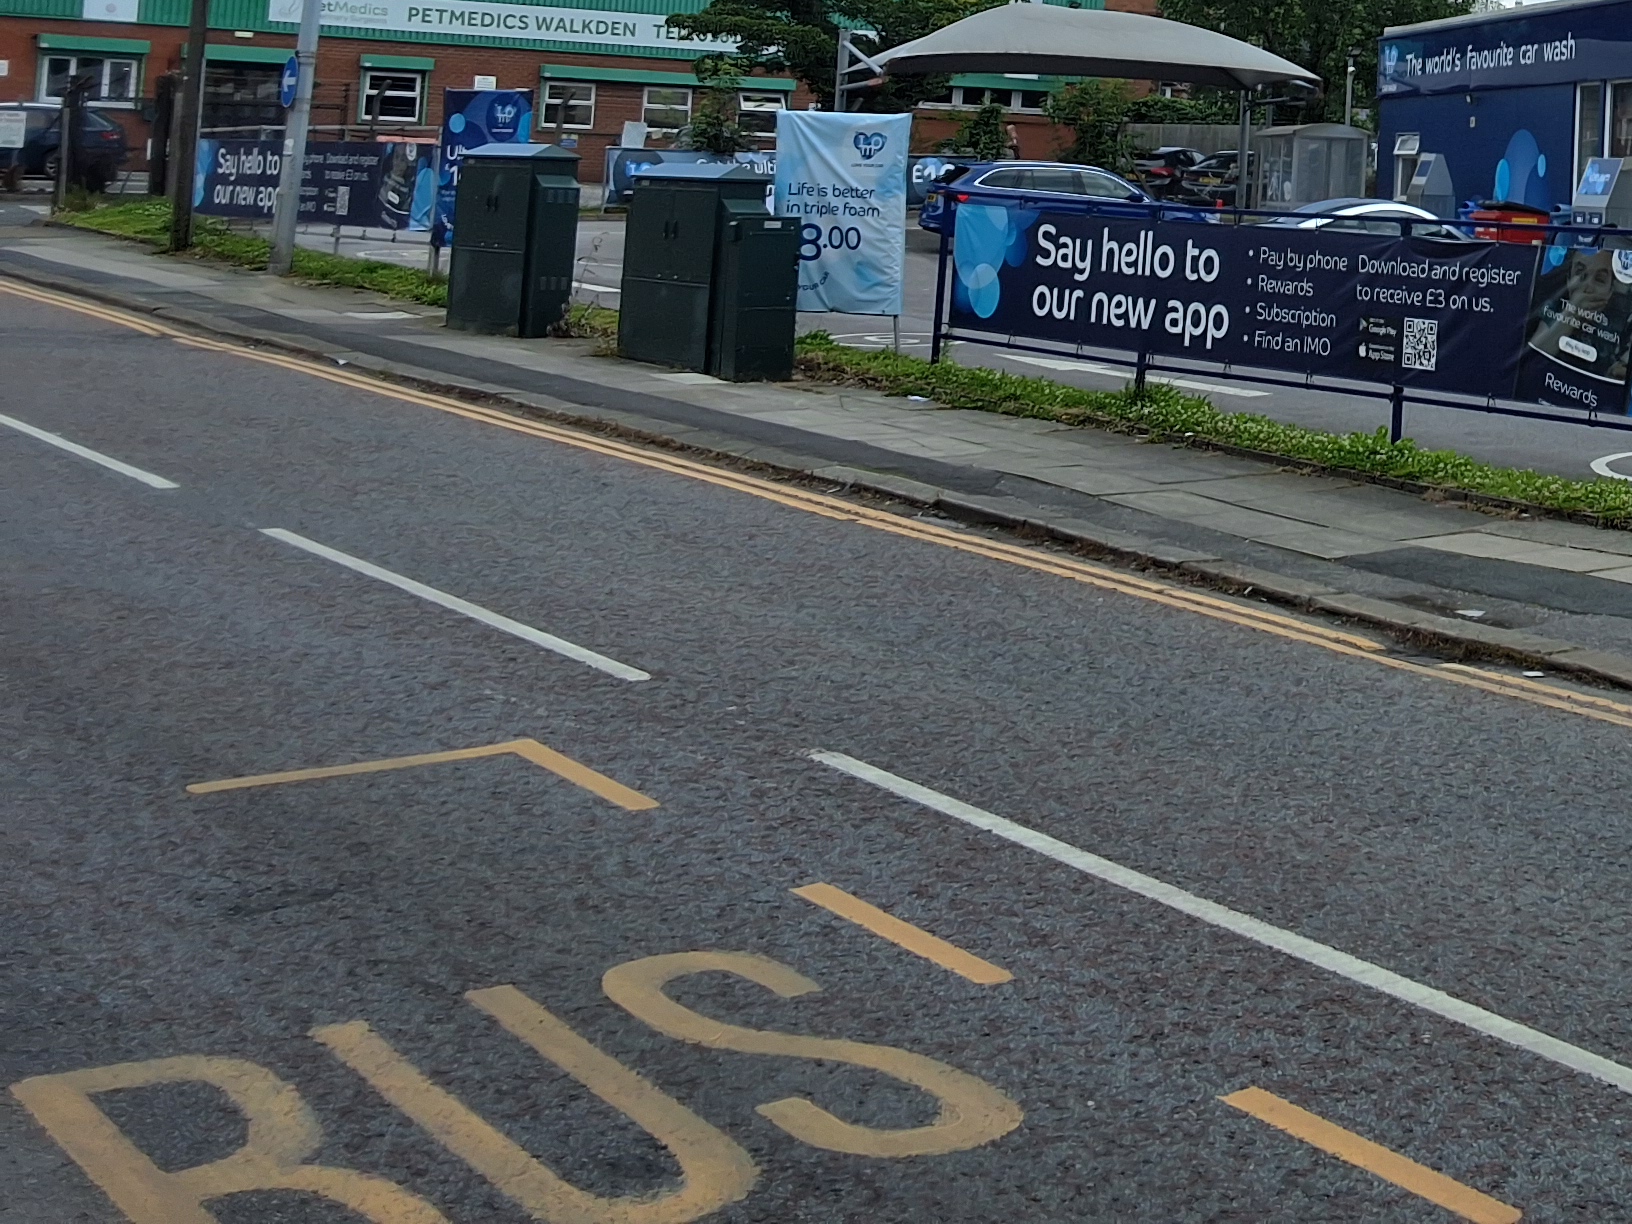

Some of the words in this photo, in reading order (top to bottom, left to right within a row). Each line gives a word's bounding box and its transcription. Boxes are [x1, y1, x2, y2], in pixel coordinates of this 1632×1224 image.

[320, 1, 388, 17] etMedics
[408, 7, 529, 30] PETMEDICS
[535, 15, 637, 37] WALKDEN
[1406, 52, 1422, 77] The
[1425, 46, 1461, 74] world's
[1466, 40, 1514, 70] favourite
[1519, 43, 1538, 64] car
[1544, 32, 1576, 62] wash
[217, 148, 238, 181] Say
[239, 147, 263, 175] hello
[266, 151, 280, 175] to
[214, 185, 234, 204] our
[233, 186, 256, 205] new
[788, 182, 814, 196] Life
[817, 185, 828, 197] is
[833, 184, 875, 199] better
[786, 200, 800, 213] in
[804, 202, 839, 218] triple
[843, 202, 880, 217] foam
[1035, 223, 1093, 282] Say
[1101, 227, 1175, 278] hello
[1185, 238, 1220, 282] to
[1260, 246, 1285, 270] Pay
[1287, 247, 1303, 271] by
[1307, 250, 1348, 272] phone
[1258, 274, 1314, 296] Rewards
[1358, 254, 1429, 278] Download
[1431, 261, 1460, 281] and
[1462, 264, 1522, 287] register
[1356, 284, 1371, 300] to
[1373, 285, 1423, 306] receive
[1426, 288, 1446, 308] £3
[1449, 294, 1468, 310] on
[1472, 297, 1494, 313] us.
[1560, 298, 1576, 314] The
[1578, 306, 1609, 326] world's
[1032, 284, 1084, 321] our
[1091, 291, 1157, 330] new
[1164, 299, 1229, 350] app
[1256, 302, 1336, 328] Subscription
[1543, 306, 1581, 329] favourite
[1582, 323, 1596, 335] car
[1597, 327, 1620, 344] wash
[1254, 330, 1282, 350] Find
[1284, 337, 1300, 352] an
[1303, 336, 1331, 356] IMO
[1545, 372, 1598, 407] Rewards
[8, 948, 1026, 1224] BUS
